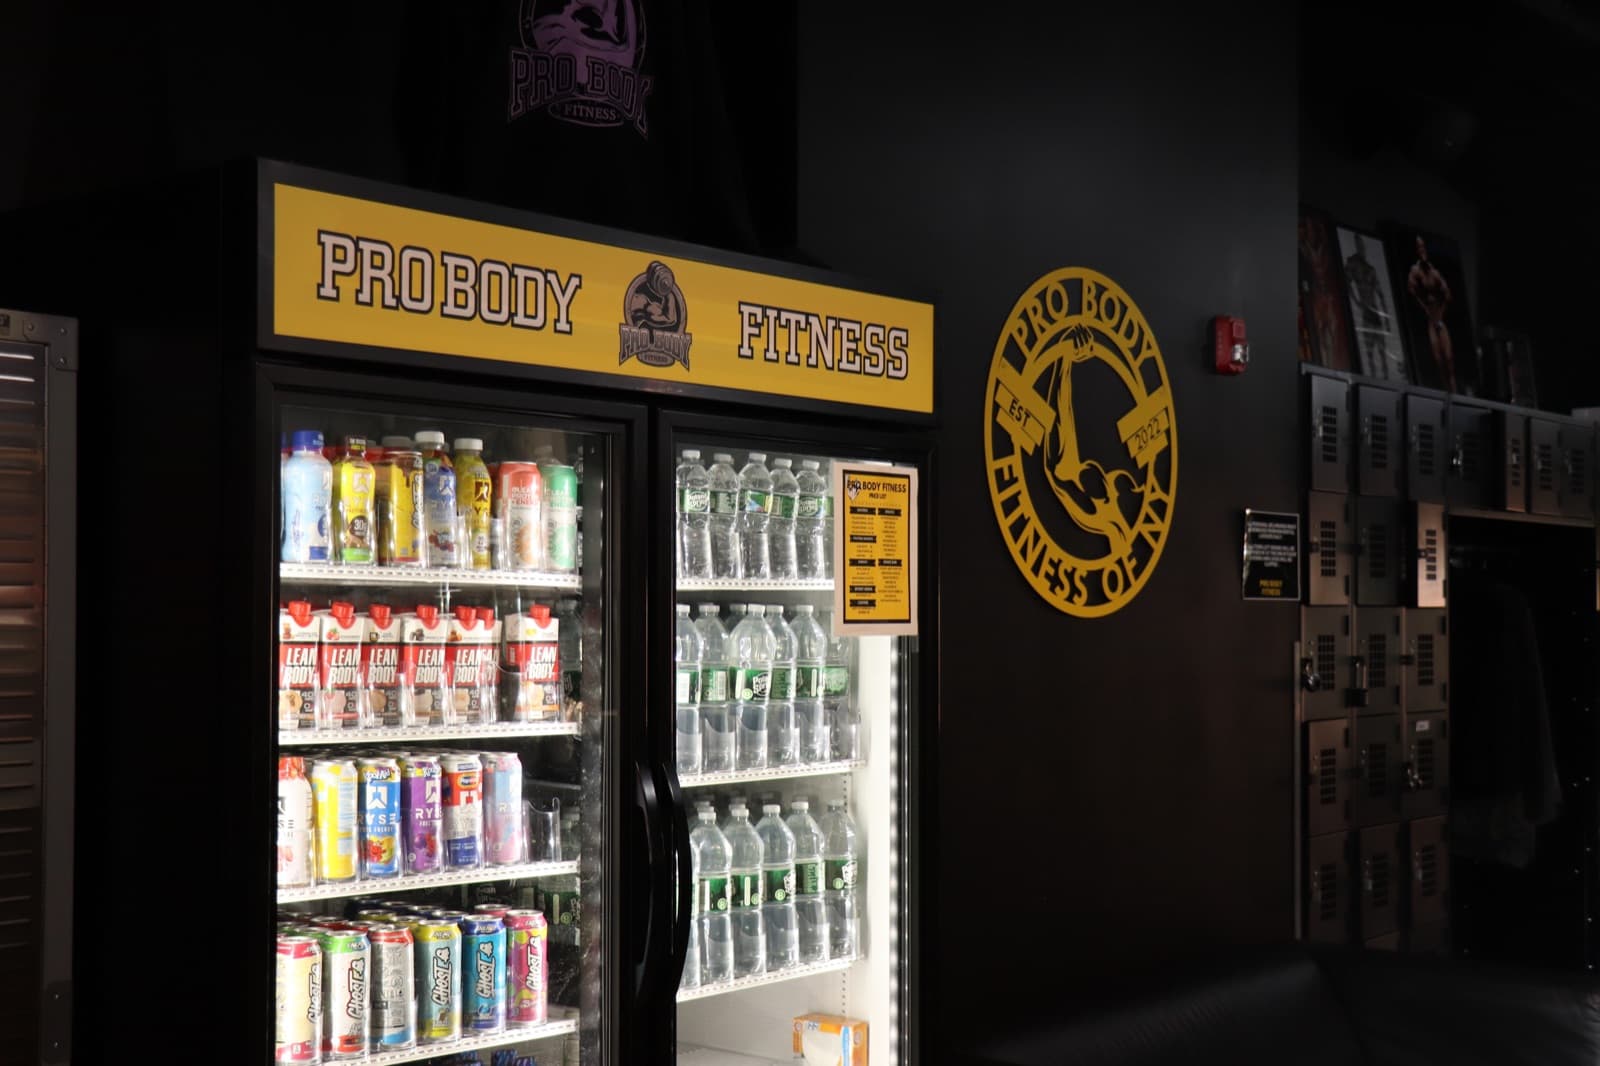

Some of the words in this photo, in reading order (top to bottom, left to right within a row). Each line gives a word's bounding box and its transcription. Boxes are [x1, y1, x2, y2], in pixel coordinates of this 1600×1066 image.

[510, 50, 577, 119] PRO
[586, 55, 656, 138] BODY
[563, 104, 618, 120] FITNESS
[317, 229, 434, 314] PRO
[441, 251, 582, 335] BODY
[1010, 280, 1068, 354] PRO
[1082, 278, 1156, 366] BODY
[738, 301, 909, 380] FITNESS
[1008, 399, 1031, 427] EST
[1134, 417, 1161, 449] 2022
[862, 481, 881, 491] BODY
[882, 483, 906, 493] FITNESS
[993, 455, 1089, 606] FITNESS
[1102, 556, 1138, 601] OF
[1138, 474, 1170, 551] NY
[286, 648, 317, 665] LEAN
[331, 648, 360, 666] LEAN
[370, 648, 399, 666] LEAN
[418, 649, 446, 665] LEAN
[456, 649, 482, 665] LEAN
[531, 646, 558, 663] LEAN
[283, 666, 315, 683] BODY
[329, 667, 359, 684] BODY
[368, 667, 397, 683] BODY
[415, 666, 442, 683] BODY
[454, 667, 480, 684] BODY
[528, 664, 554, 680] BODY
[475, 950, 496, 999] GHOST
[525, 945, 542, 991] GHOST
[432, 956, 452, 1006] GHOST
[346, 967, 365, 1020] GHOST
